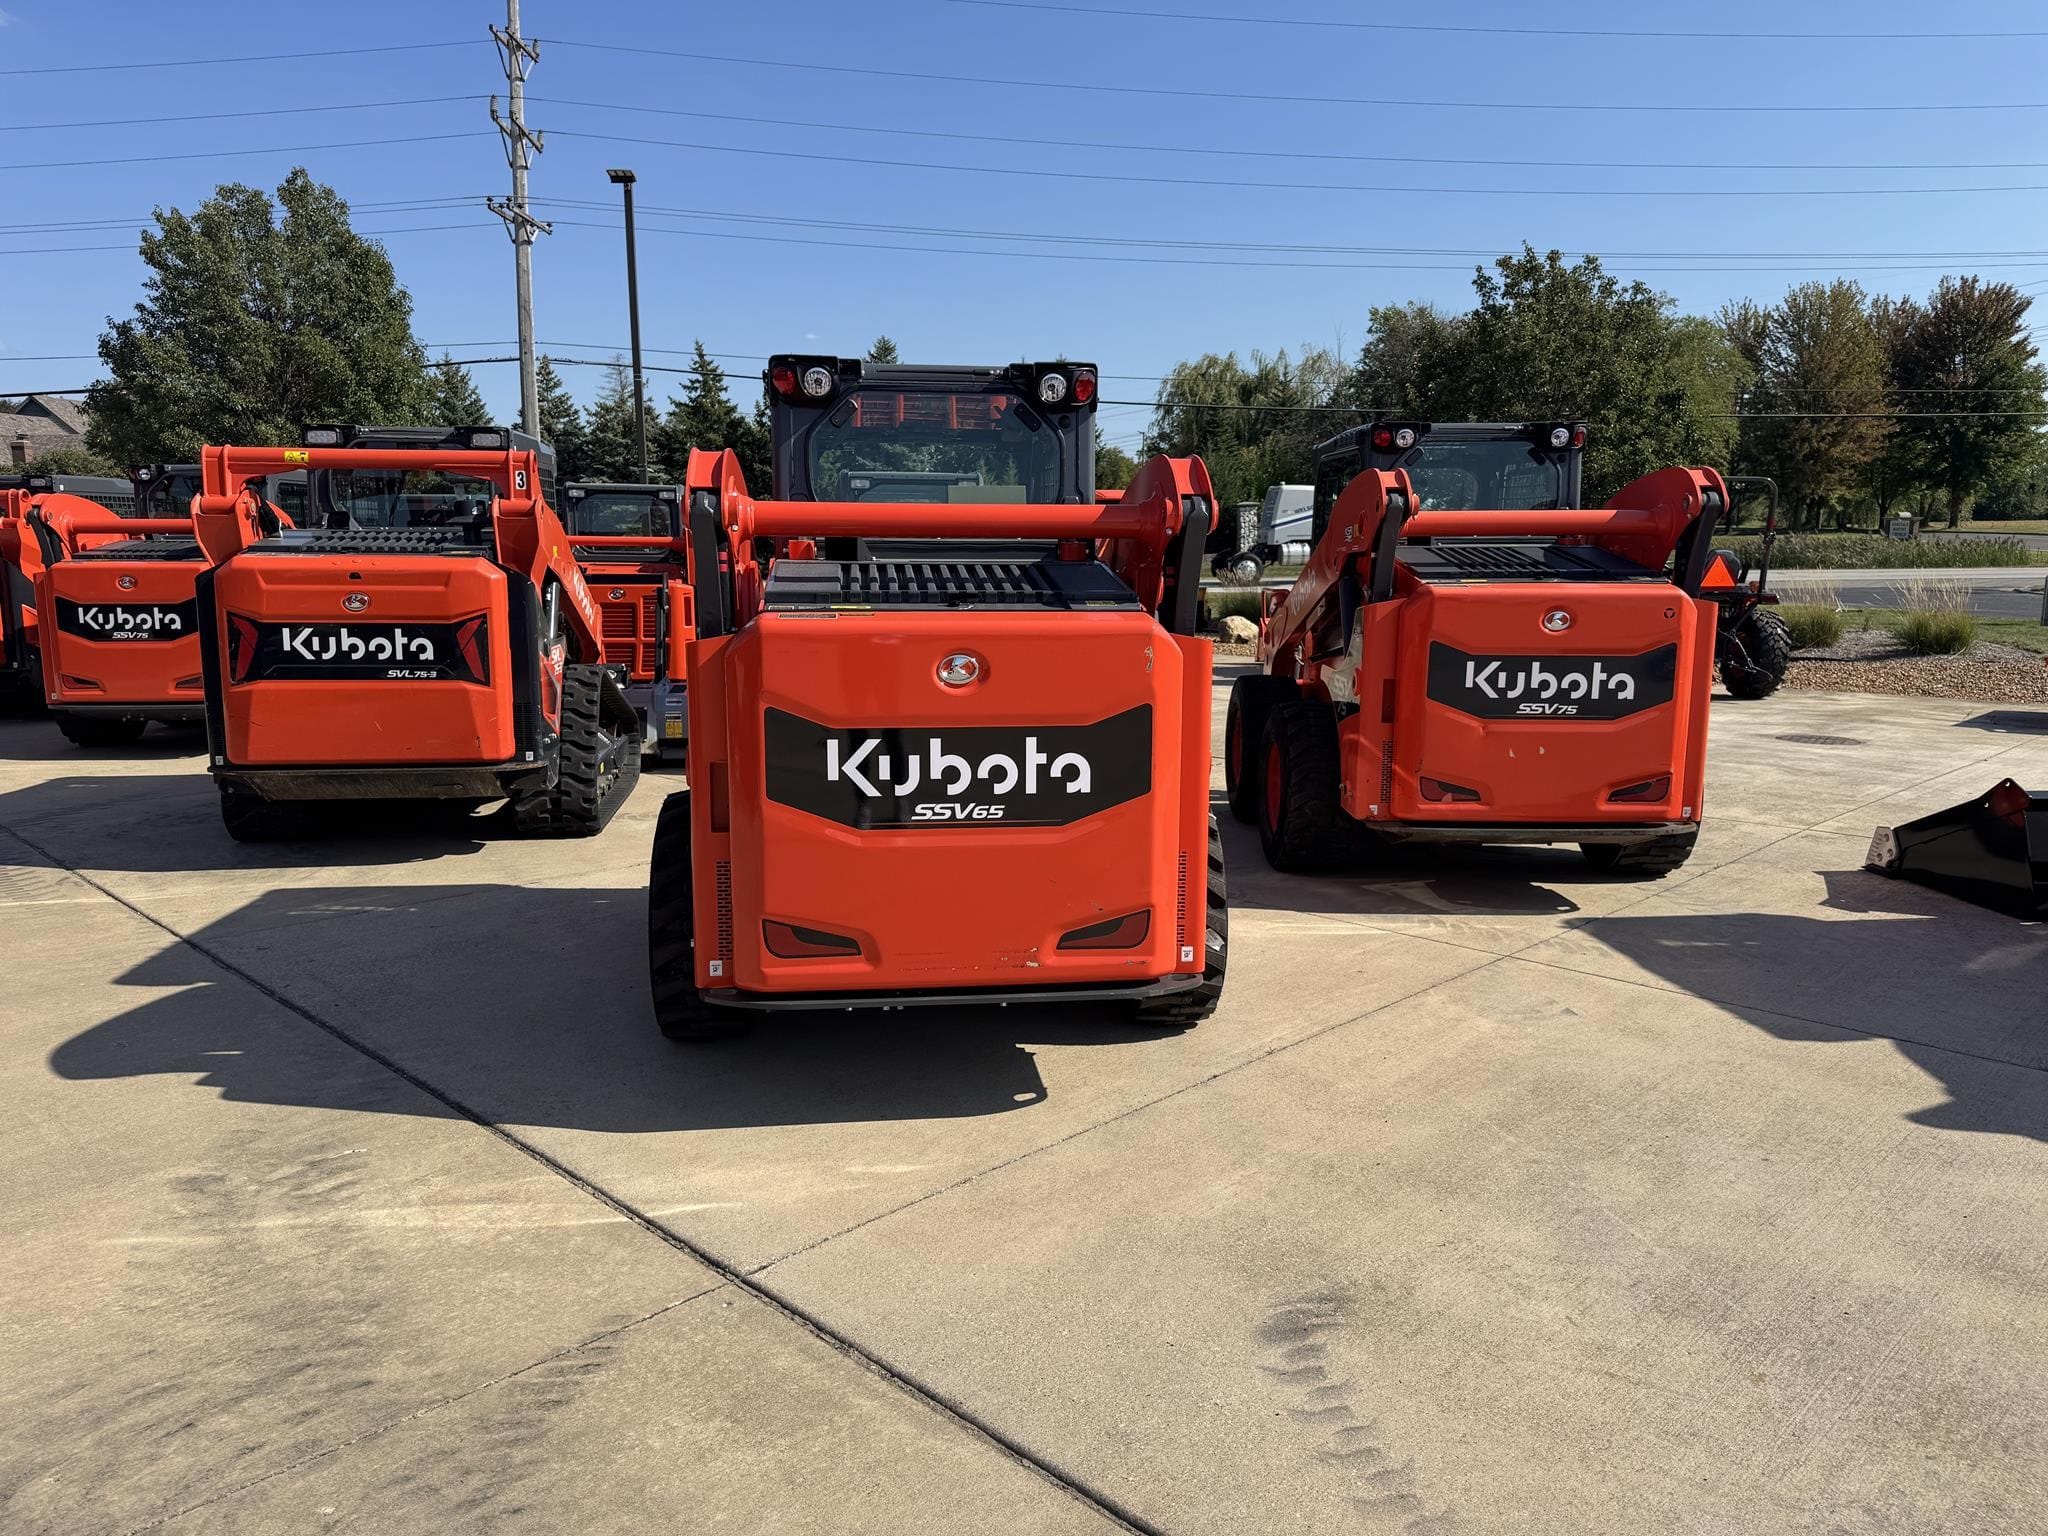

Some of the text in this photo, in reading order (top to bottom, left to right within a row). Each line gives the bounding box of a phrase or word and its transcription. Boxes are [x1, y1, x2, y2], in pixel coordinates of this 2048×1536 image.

[517, 472, 525, 489] 3
[78, 607, 182, 630] Kubota
[111, 631, 149, 639] SSV75
[283, 627, 434, 661] Kubota
[1465, 661, 1635, 700] Kubota
[1516, 703, 1579, 715] SSV75
[826, 736, 1092, 798] Kubota
[911, 803, 1006, 820] SSV65
